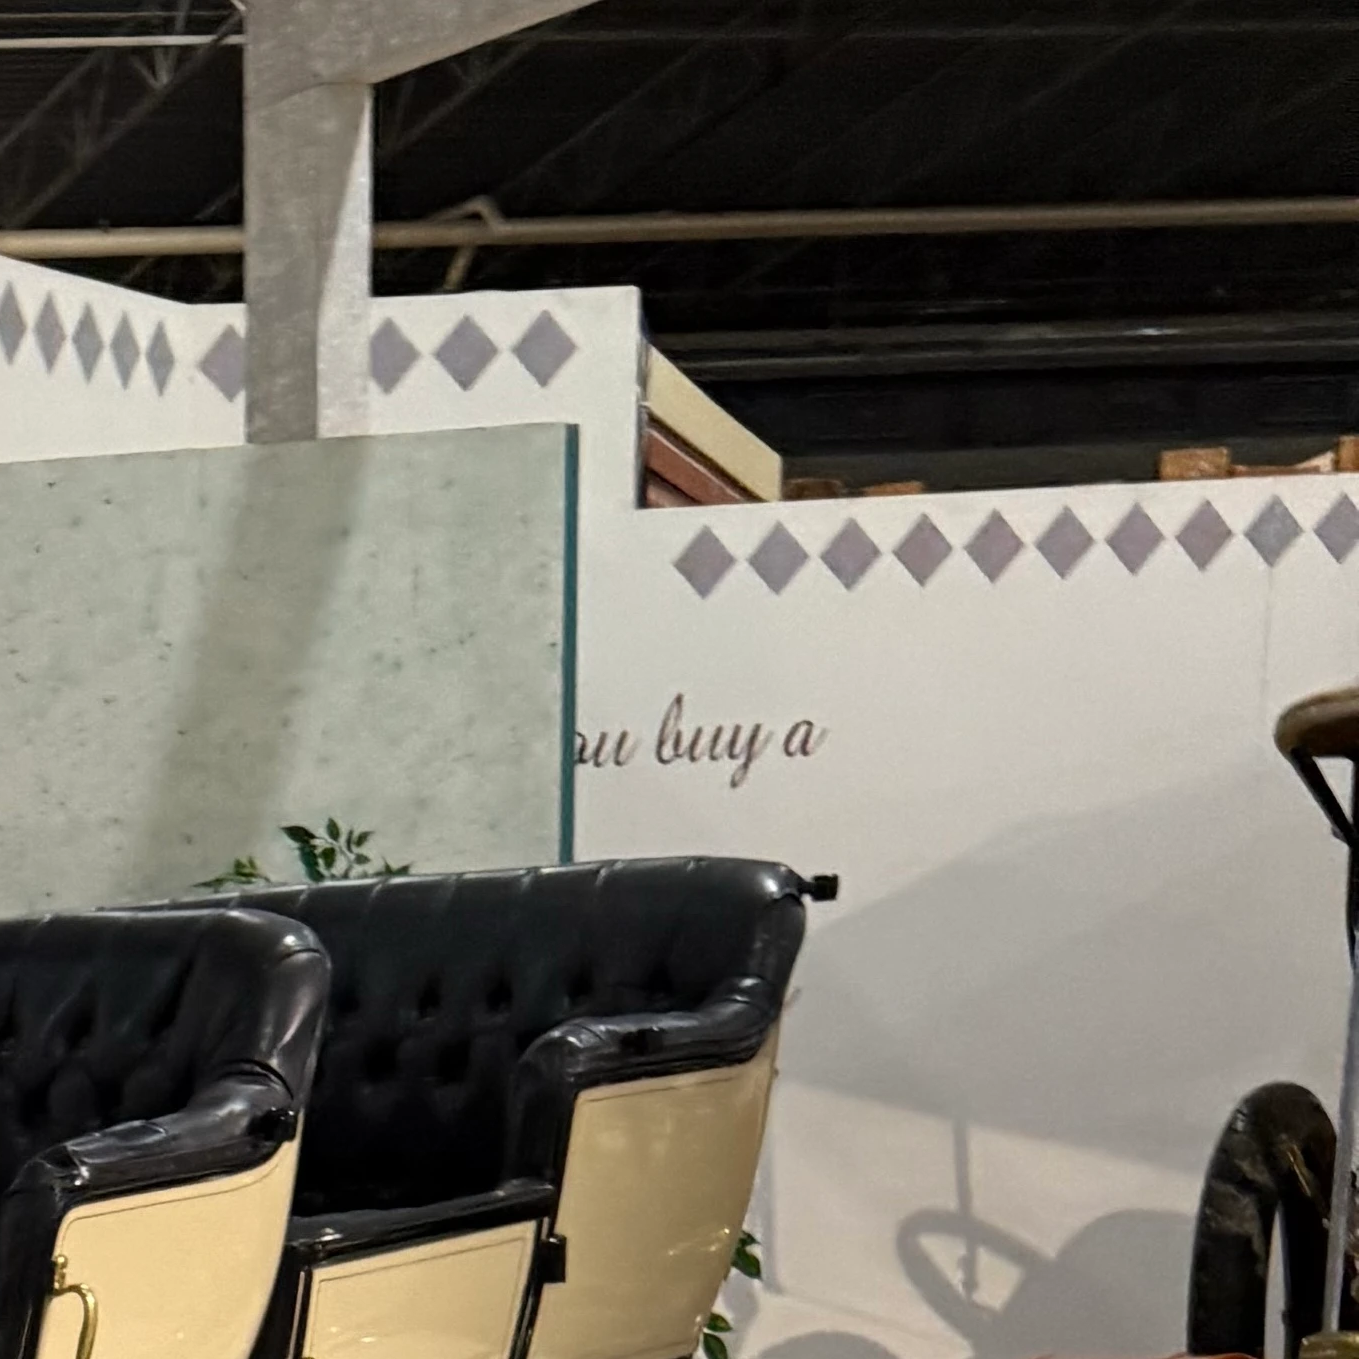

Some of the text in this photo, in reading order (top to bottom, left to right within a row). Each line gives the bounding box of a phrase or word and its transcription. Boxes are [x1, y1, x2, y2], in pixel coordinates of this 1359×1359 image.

[576, 692, 829, 790] u buy a
